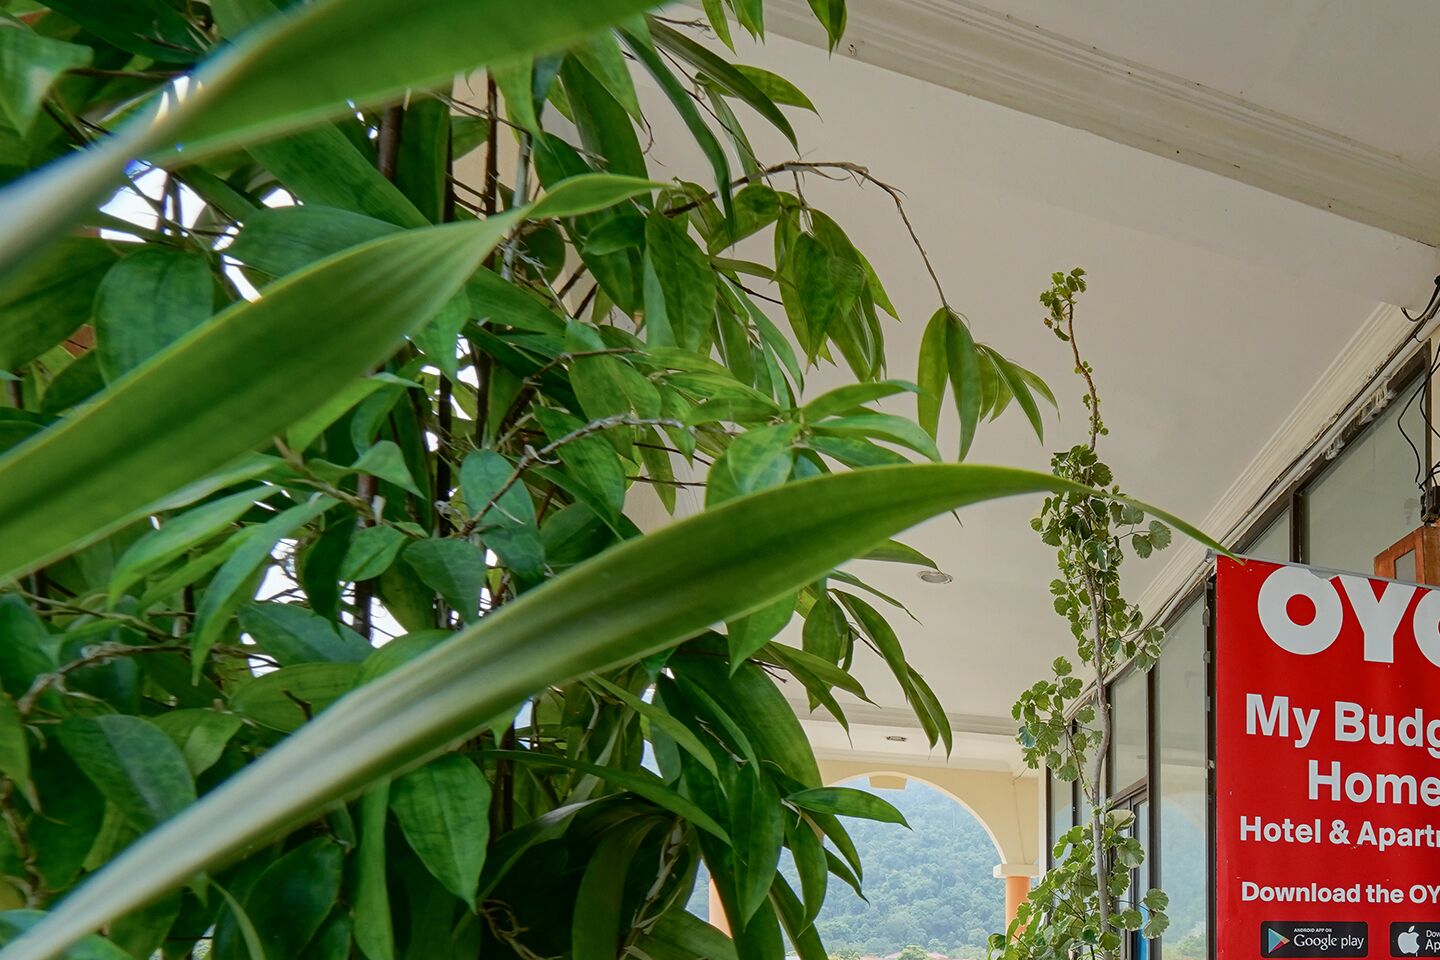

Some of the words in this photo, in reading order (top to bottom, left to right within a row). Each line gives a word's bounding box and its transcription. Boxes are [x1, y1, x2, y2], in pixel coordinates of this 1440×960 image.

[1246, 693, 1320, 748] My
[1240, 816, 1321, 844] Hotel
[1329, 820, 1350, 845] &
[1241, 882, 1361, 903] Download
[1366, 884, 1404, 903] the
[1294, 933, 1337, 950] Google
[1341, 936, 1364, 948] play
